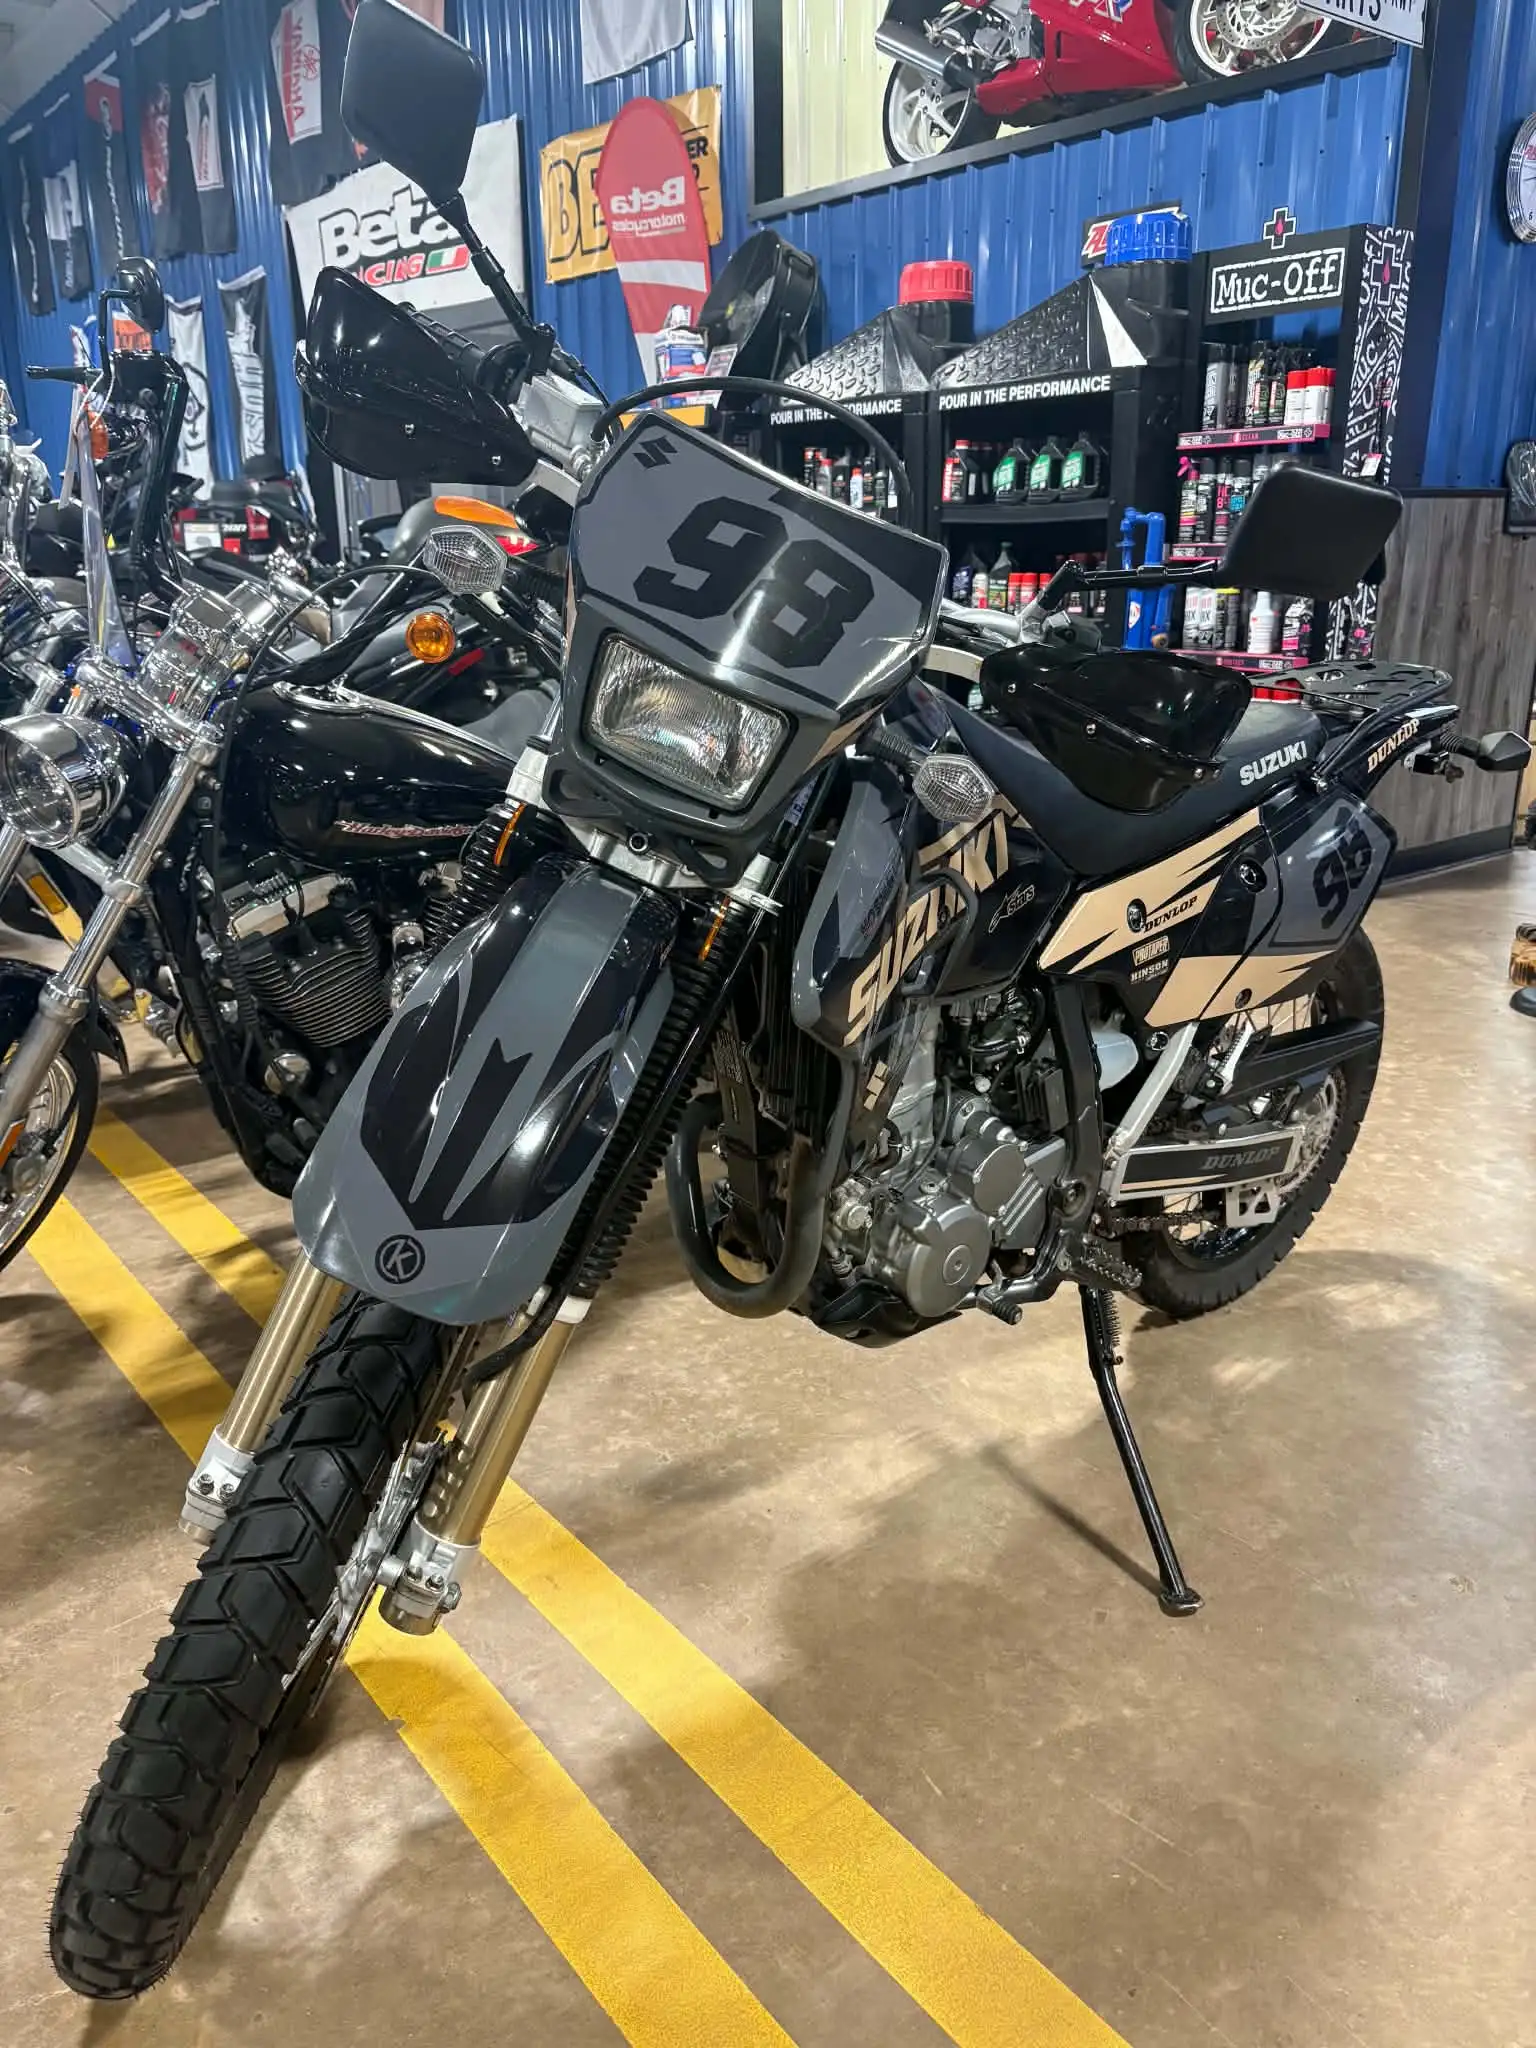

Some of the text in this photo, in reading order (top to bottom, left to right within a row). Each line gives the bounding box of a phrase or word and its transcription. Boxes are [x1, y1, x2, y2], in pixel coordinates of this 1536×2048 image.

[686, 136, 708, 160] ER
[319, 184, 460, 269] Beta
[357, 252, 426, 288] CING
[1215, 254, 1340, 307] Muc-Off
[939, 375, 1112, 410] POUR IN THE PERFORMANCE
[770, 398, 902, 425] POUR IN THE PORMANCE
[633, 496, 875, 669] 98
[1240, 741, 1308, 786] SUZUKI
[1367, 719, 1420, 774] DUNLOP
[1143, 896, 1198, 933] DUNLOP
[1130, 959, 1169, 982] HINSON
[1202, 1146, 1281, 1170] DUNLOP
